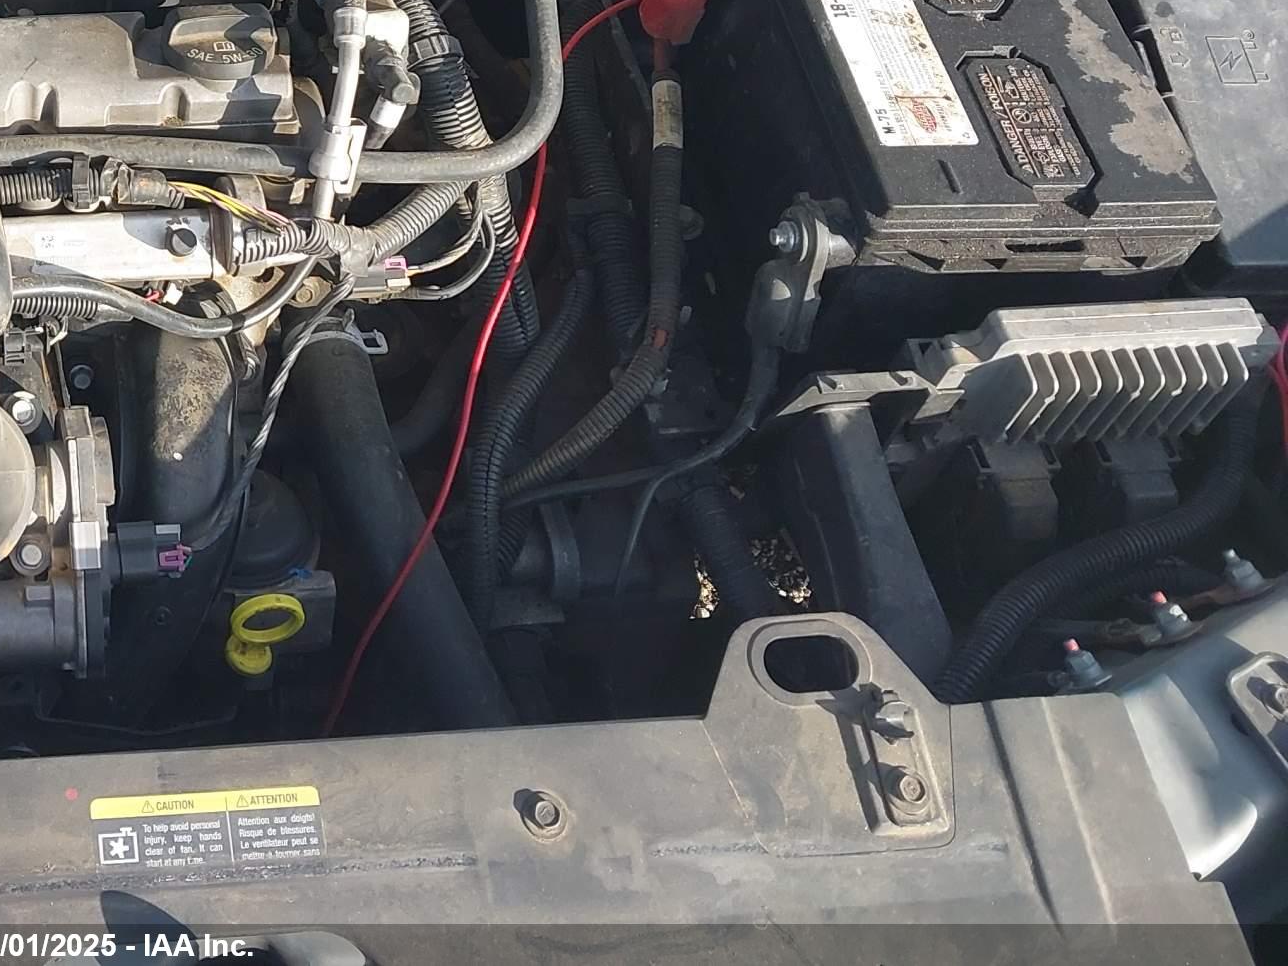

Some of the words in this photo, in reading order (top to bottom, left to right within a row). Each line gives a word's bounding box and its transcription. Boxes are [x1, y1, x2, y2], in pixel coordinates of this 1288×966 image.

[187, 48, 214, 63] SAE
[222, 47, 264, 64] 5W-30
[977, 72, 1004, 111] POISON
[874, 108, 897, 134] M-75
[999, 118, 1031, 165] DANGER
[156, 799, 195, 811] CAUTION
[249, 793, 298, 805] ATTENTION
[142, 824, 152, 833] To
[153, 823, 169, 833] help
[170, 822, 189, 831] avoid
[190, 820, 221, 831] personal
[238, 817, 270, 827] Attention
[274, 816, 288, 824] aux
[173, 834, 193, 844] keep
[199, 832, 222, 841] hands
[239, 829, 264, 839] Risque
[267, 827, 277, 836] de
[240, 841, 250, 850] Le
[252, 839, 289, 848] ventilateur
[292, 837, 308, 847] peut
[310, 837, 319, 845] se
[145, 847, 164, 856] clear
[168, 845, 176, 855] of
[180, 845, 196, 854] fan.
[199, 844, 206, 853] It
[209, 844, 224, 852] can
[146, 858, 163, 867] start
[164, 858, 172, 867] at
[172, 858, 186, 867] any
